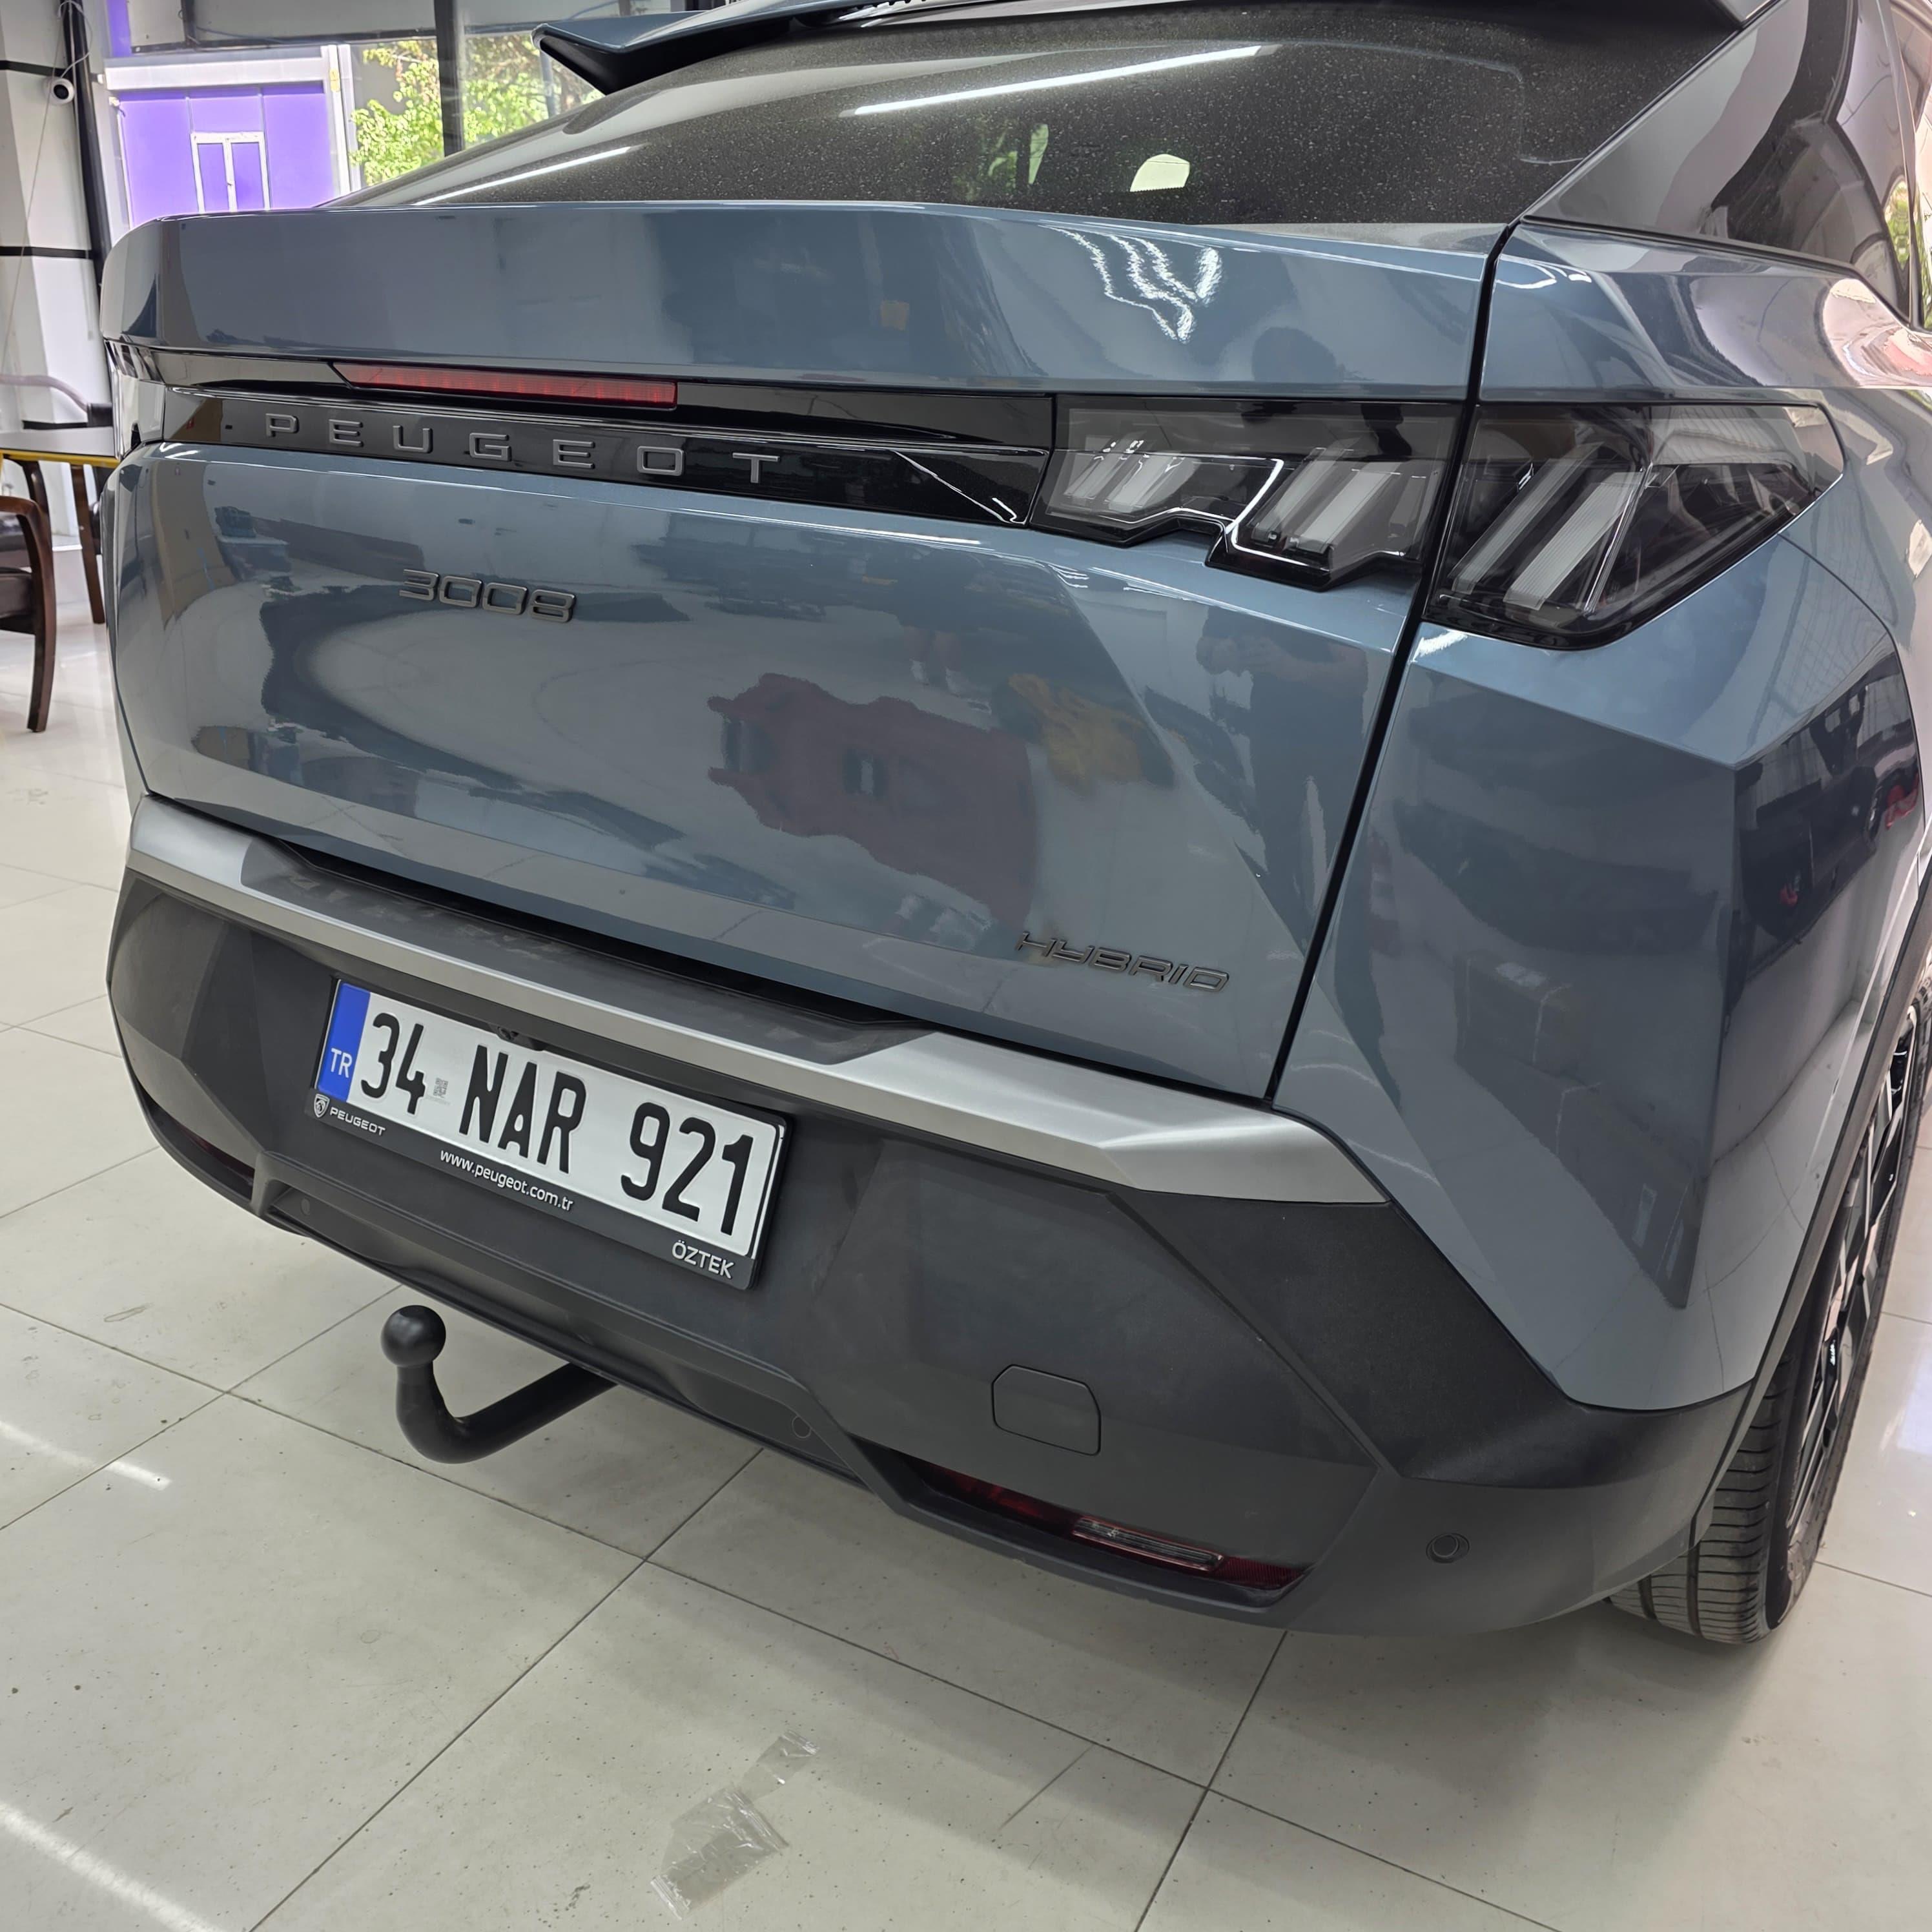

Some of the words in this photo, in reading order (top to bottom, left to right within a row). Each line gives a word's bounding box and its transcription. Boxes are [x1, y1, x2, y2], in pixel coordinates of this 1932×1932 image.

[265, 412, 780, 484] PEUGEOT
[398, 568, 577, 623] 3008
[1014, 930, 1230, 993] HYBRID
[331, 1047, 353, 1078] TR
[330, 1105, 386, 1136] PEUGEOT
[360, 1012, 426, 1115] 34
[458, 1044, 587, 1174] NAR
[620, 1101, 754, 1237] 921
[440, 1149, 573, 1211] www.peugeot.com.tr
[672, 1239, 734, 1279] ÖZTEK
